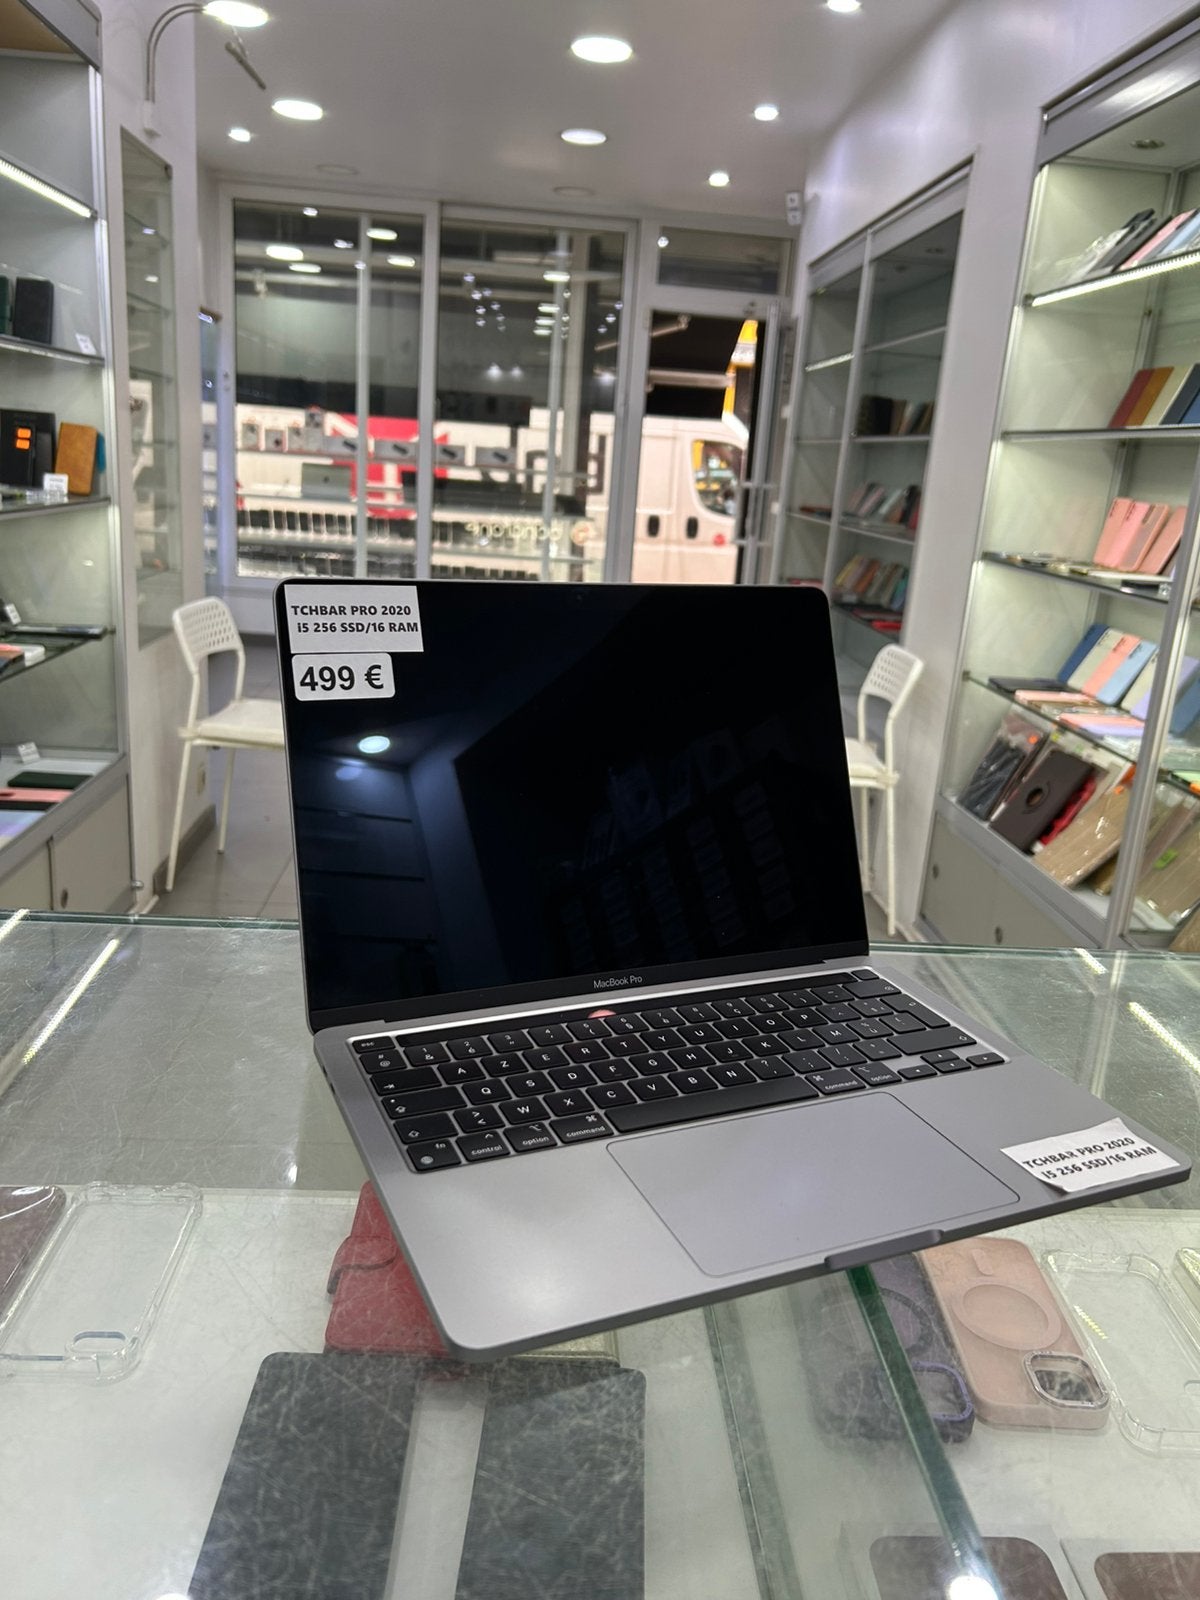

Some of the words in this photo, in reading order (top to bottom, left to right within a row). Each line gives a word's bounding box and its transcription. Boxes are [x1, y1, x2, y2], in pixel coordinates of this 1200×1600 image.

[291, 605, 347, 616] TCHBAR
[350, 605, 378, 616] PRO
[381, 605, 411, 616] 2020
[313, 622, 337, 633] 256
[340, 622, 385, 634] SSD/16
[389, 622, 419, 633] RAM
[299, 665, 355, 692] 499
[364, 664, 384, 690] €
[593, 977, 629, 989] MacBook
[630, 975, 643, 984] Pro
[870, 1074, 894, 1082] option
[824, 1080, 858, 1090] command
[516, 1106, 530, 1114] W
[566, 1126, 606, 1138] command
[522, 1136, 550, 1146] option
[472, 1144, 502, 1156] control
[1023, 1151, 1077, 1169] TCHBAR
[1076, 1144, 1104, 1157] PRO
[1103, 1137, 1135, 1150] 2020
[1056, 1164, 1083, 1176] 256
[1081, 1153, 1127, 1170] SSD/16
[1125, 1146, 1157, 1160] RAM
